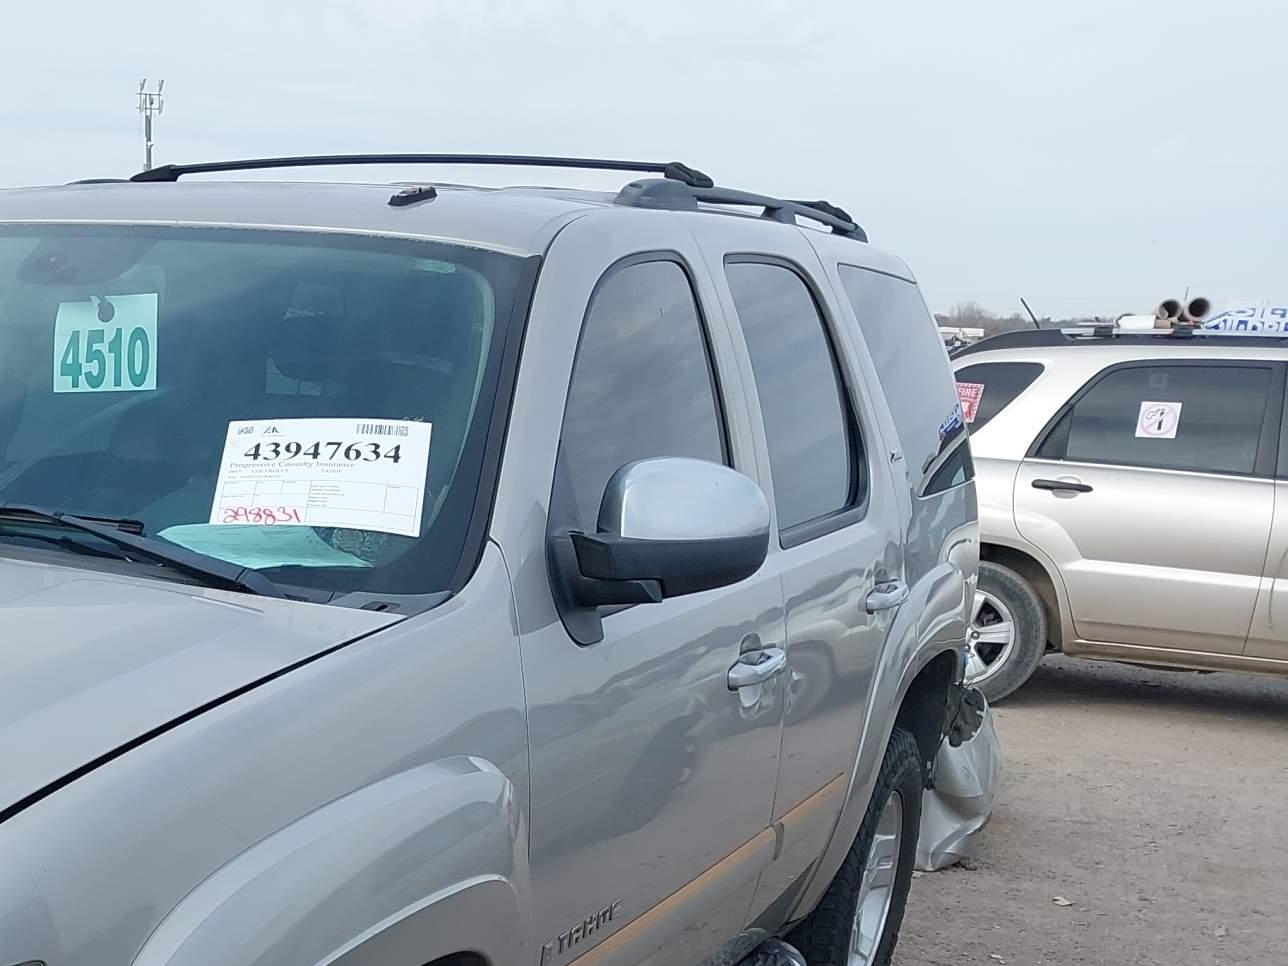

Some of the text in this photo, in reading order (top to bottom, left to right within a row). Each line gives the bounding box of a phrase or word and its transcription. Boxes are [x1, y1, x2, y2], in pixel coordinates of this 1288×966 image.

[60, 326, 150, 389] 4510
[243, 441, 402, 464] 43947634
[222, 505, 302, 527] 298831
